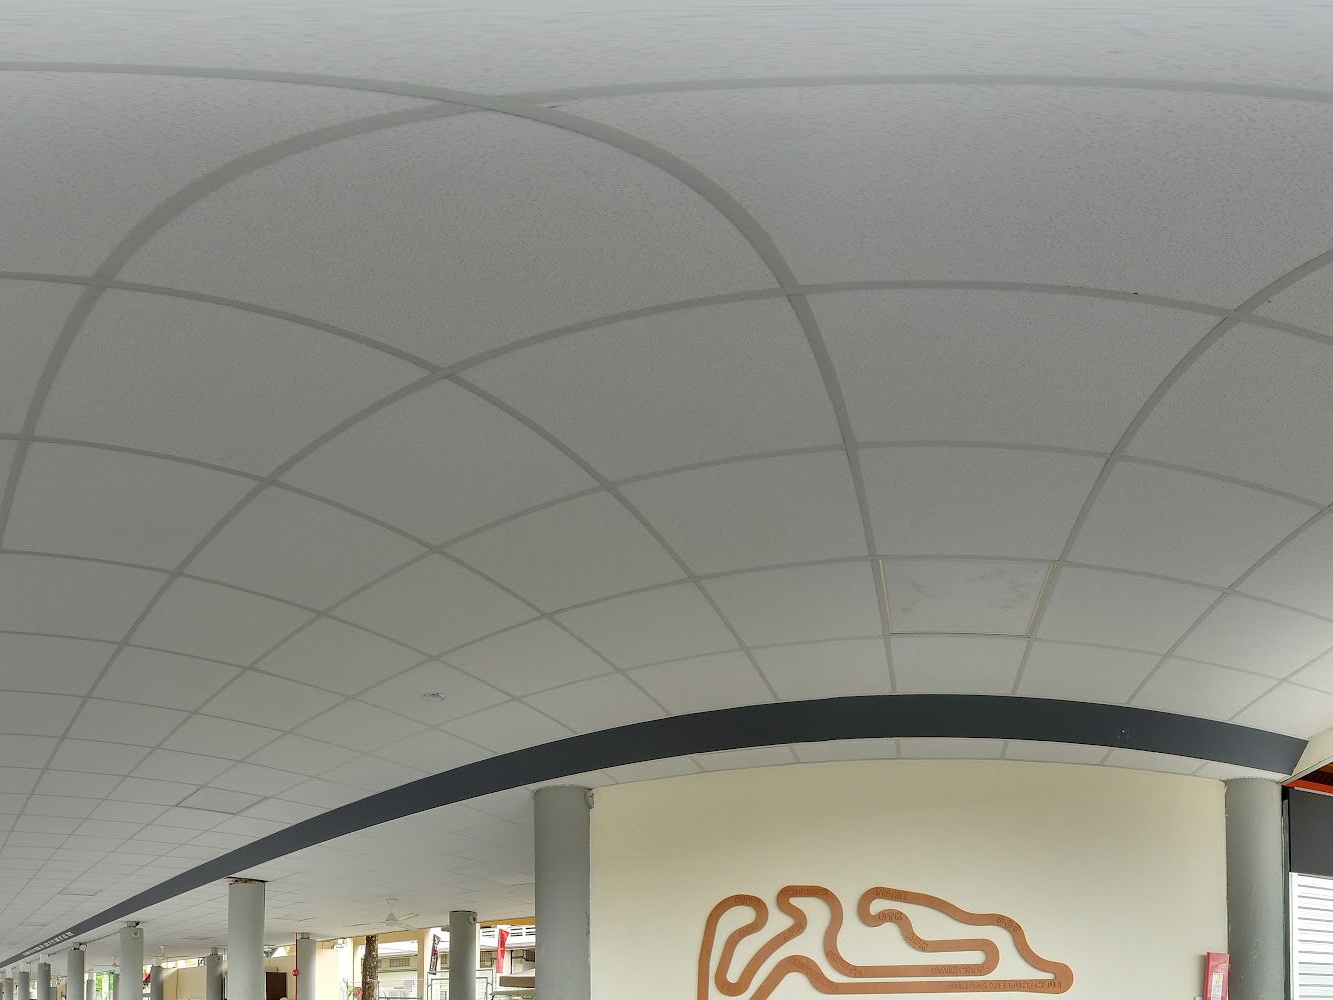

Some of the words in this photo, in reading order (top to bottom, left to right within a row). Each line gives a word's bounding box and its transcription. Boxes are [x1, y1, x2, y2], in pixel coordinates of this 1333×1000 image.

[878, 912, 903, 921] OTK
[906, 933, 929, 951] ADK
[932, 965, 958, 974] GAIN
[959, 965, 984, 974] CITY
[1006, 981, 1033, 989] TURF
[1035, 981, 1061, 989] CLUB
